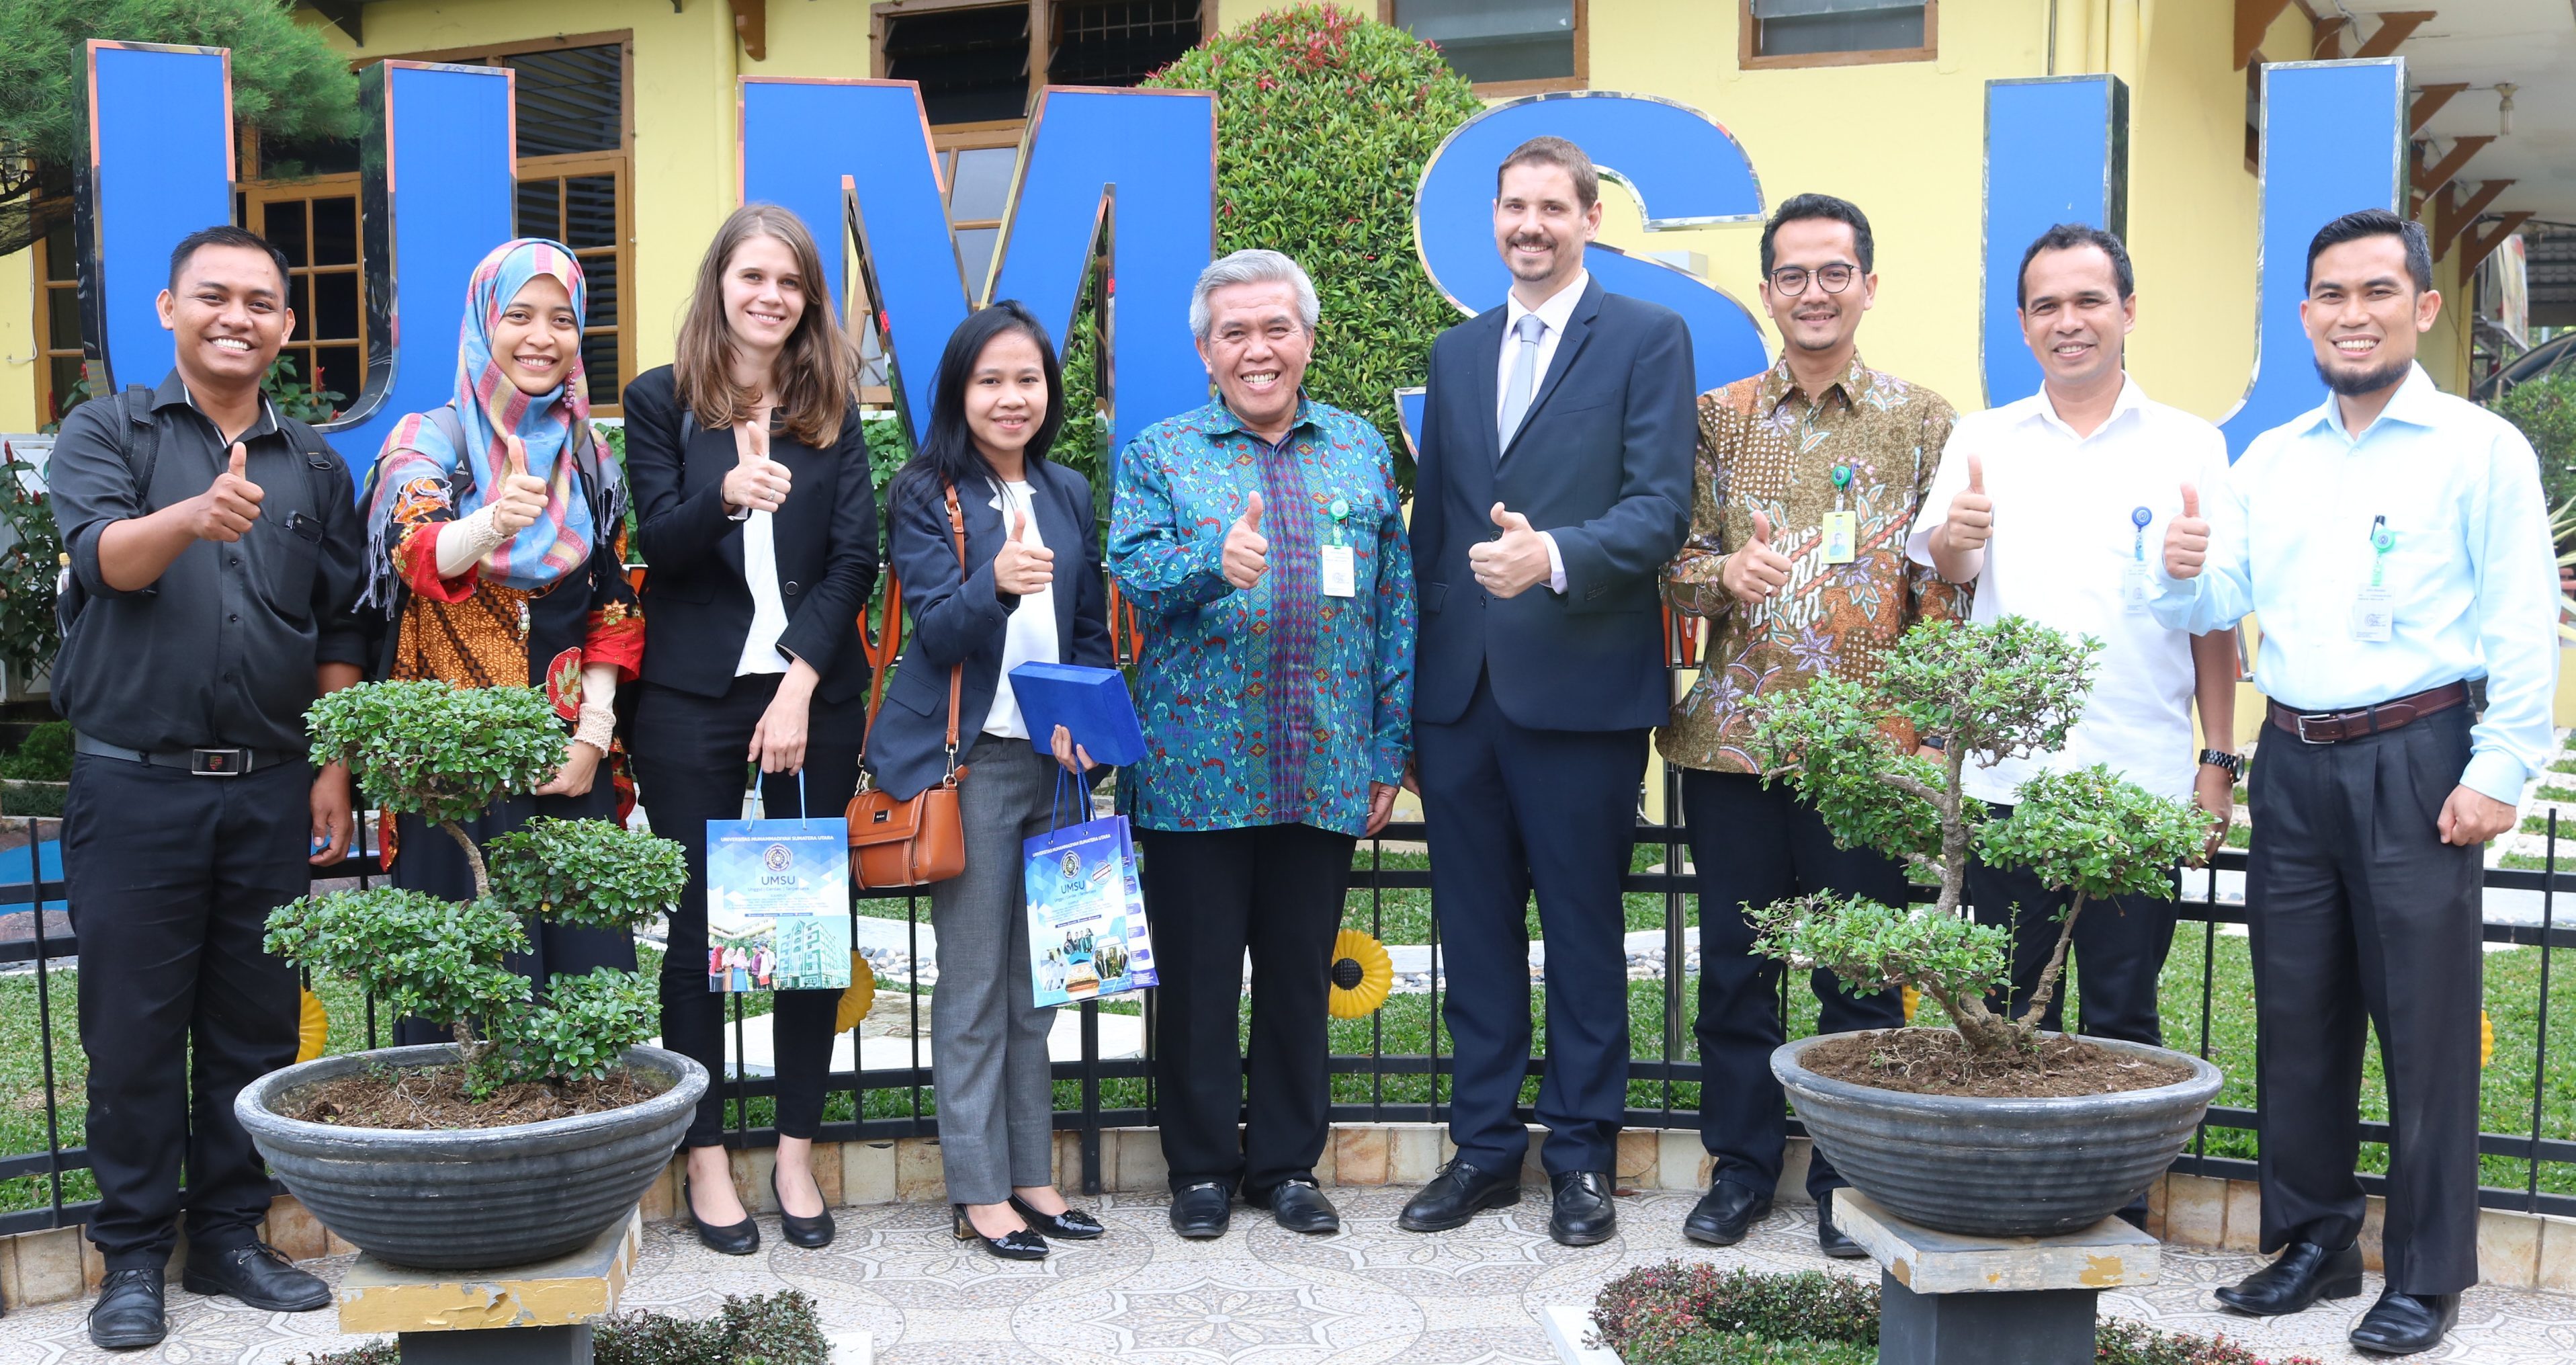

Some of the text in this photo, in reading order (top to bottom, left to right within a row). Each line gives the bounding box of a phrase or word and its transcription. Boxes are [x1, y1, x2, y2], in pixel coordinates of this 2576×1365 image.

[1032, 848, 1052, 857] UNIVERSITAS
[1079, 837, 1099, 845] SUMATERA
[761, 876, 796, 885] UMSU
[1061, 880, 1085, 894] UMSU
